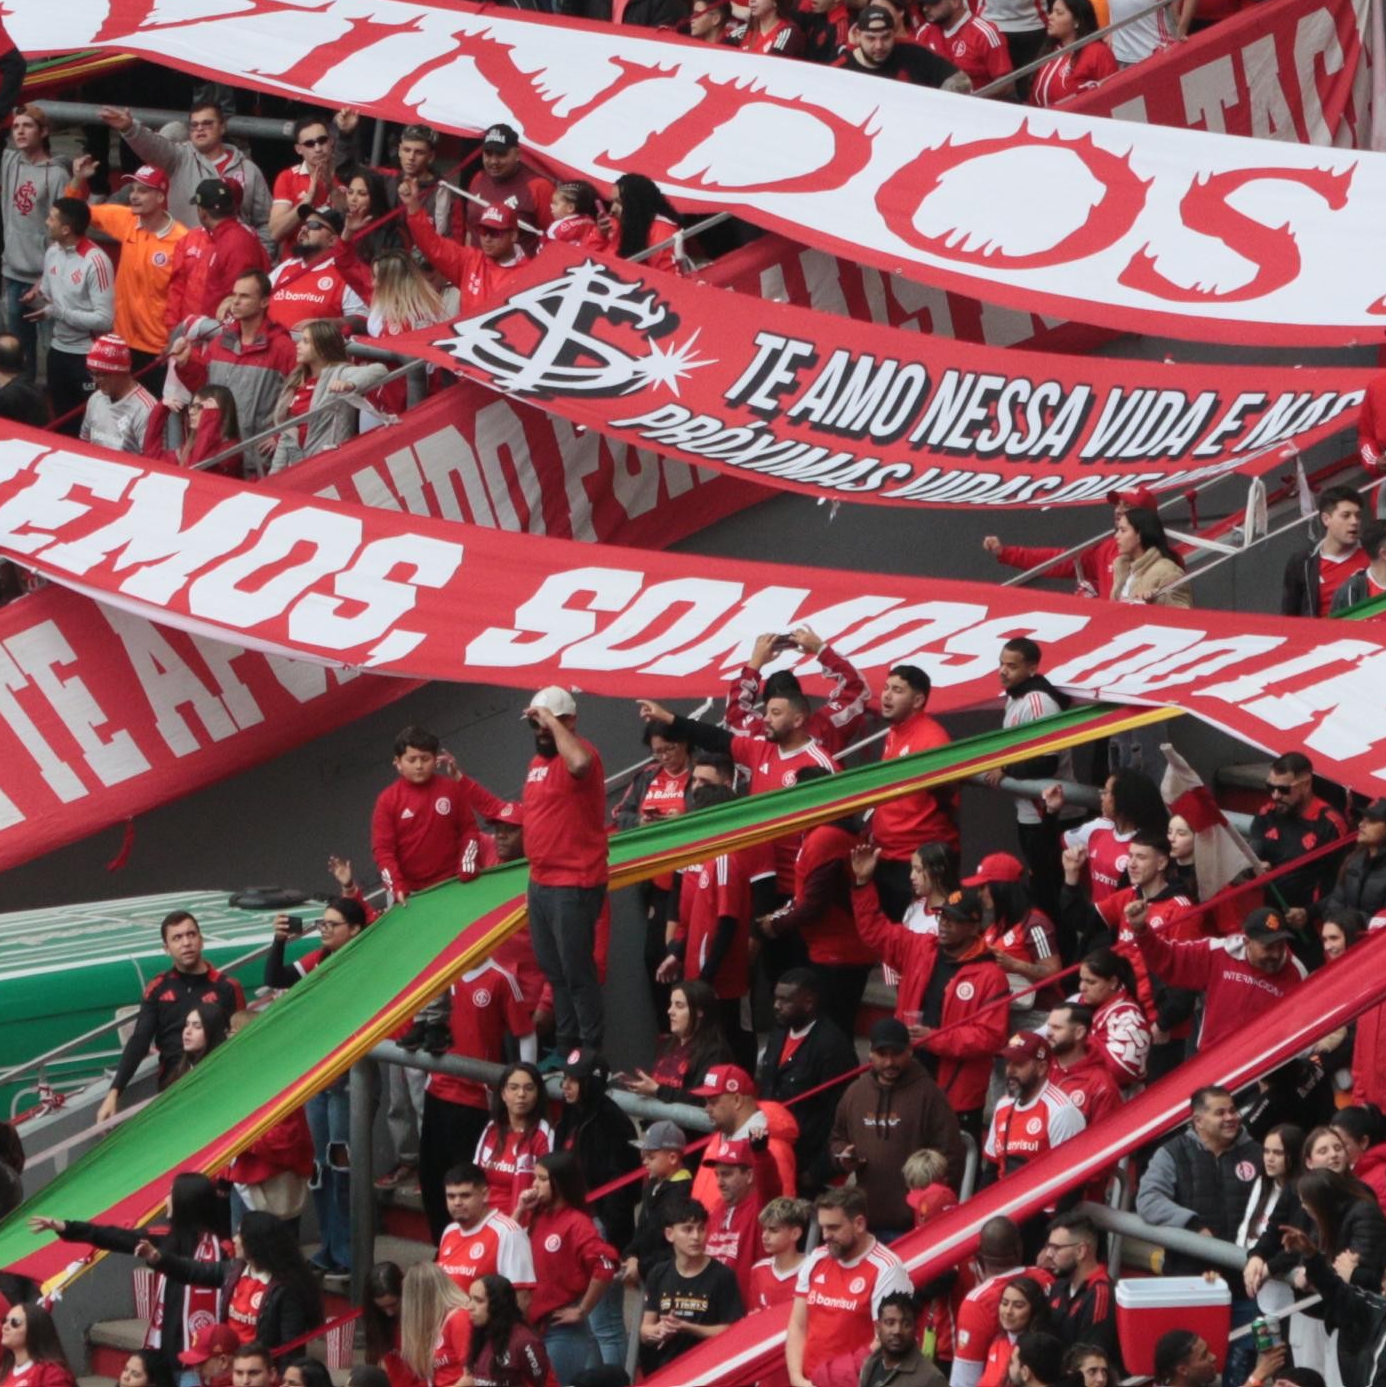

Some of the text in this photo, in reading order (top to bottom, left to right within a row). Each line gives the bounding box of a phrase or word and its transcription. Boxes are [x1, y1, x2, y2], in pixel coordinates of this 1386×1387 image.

[283, 290, 325, 304] banrisul
[725, 332, 819, 411] TE
[789, 349, 925, 441] AMO
[909, 370, 1070, 458] NESSA
[1079, 387, 1215, 459] VIDA
[1191, 392, 1265, 456] E
[610, 402, 913, 496] PRÓXIMAS
[881, 463, 1064, 505] VIDAS
[464, 566, 1093, 688] SOMOS
[1043, 624, 1289, 698] DO
[816, 1295, 857, 1311] banrisul
[524, 1344, 539, 1371] vero
